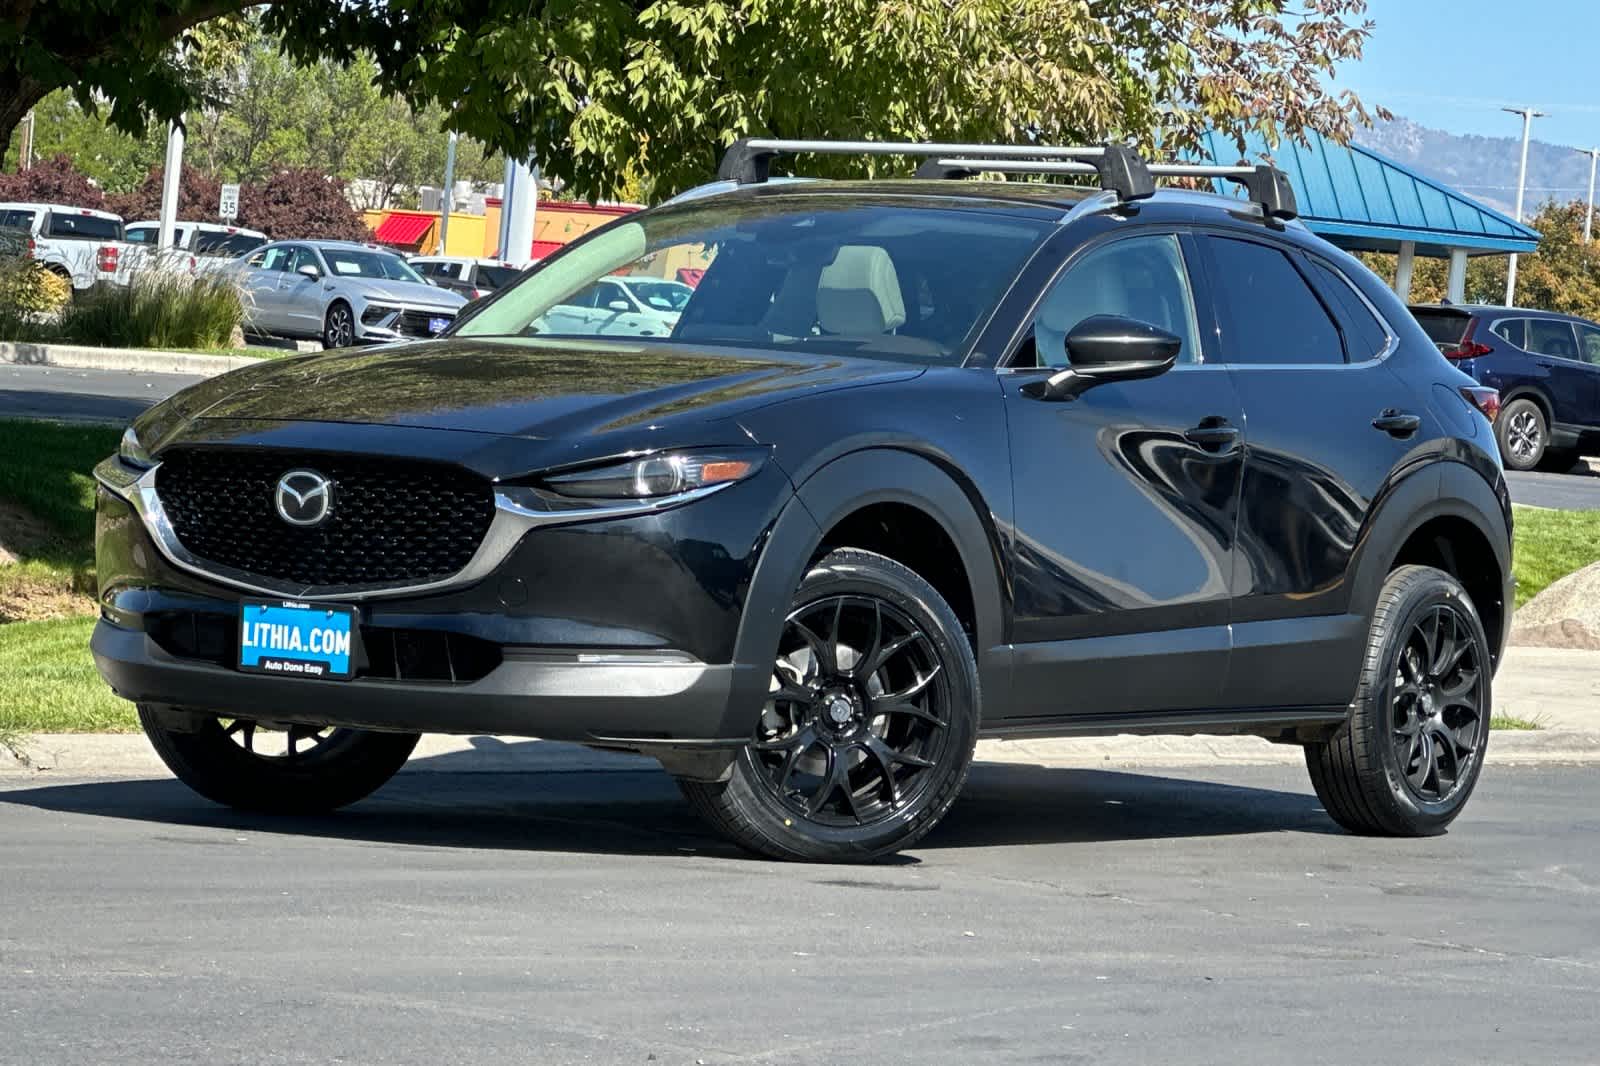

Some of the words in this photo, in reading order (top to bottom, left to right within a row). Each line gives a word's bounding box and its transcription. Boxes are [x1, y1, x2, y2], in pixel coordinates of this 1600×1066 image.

[222, 201, 236, 214] 35
[242, 621, 351, 656] LITHIA.COM
[264, 660, 283, 670] Auto
[283, 661, 304, 672] Done
[304, 663, 323, 675] Easy
